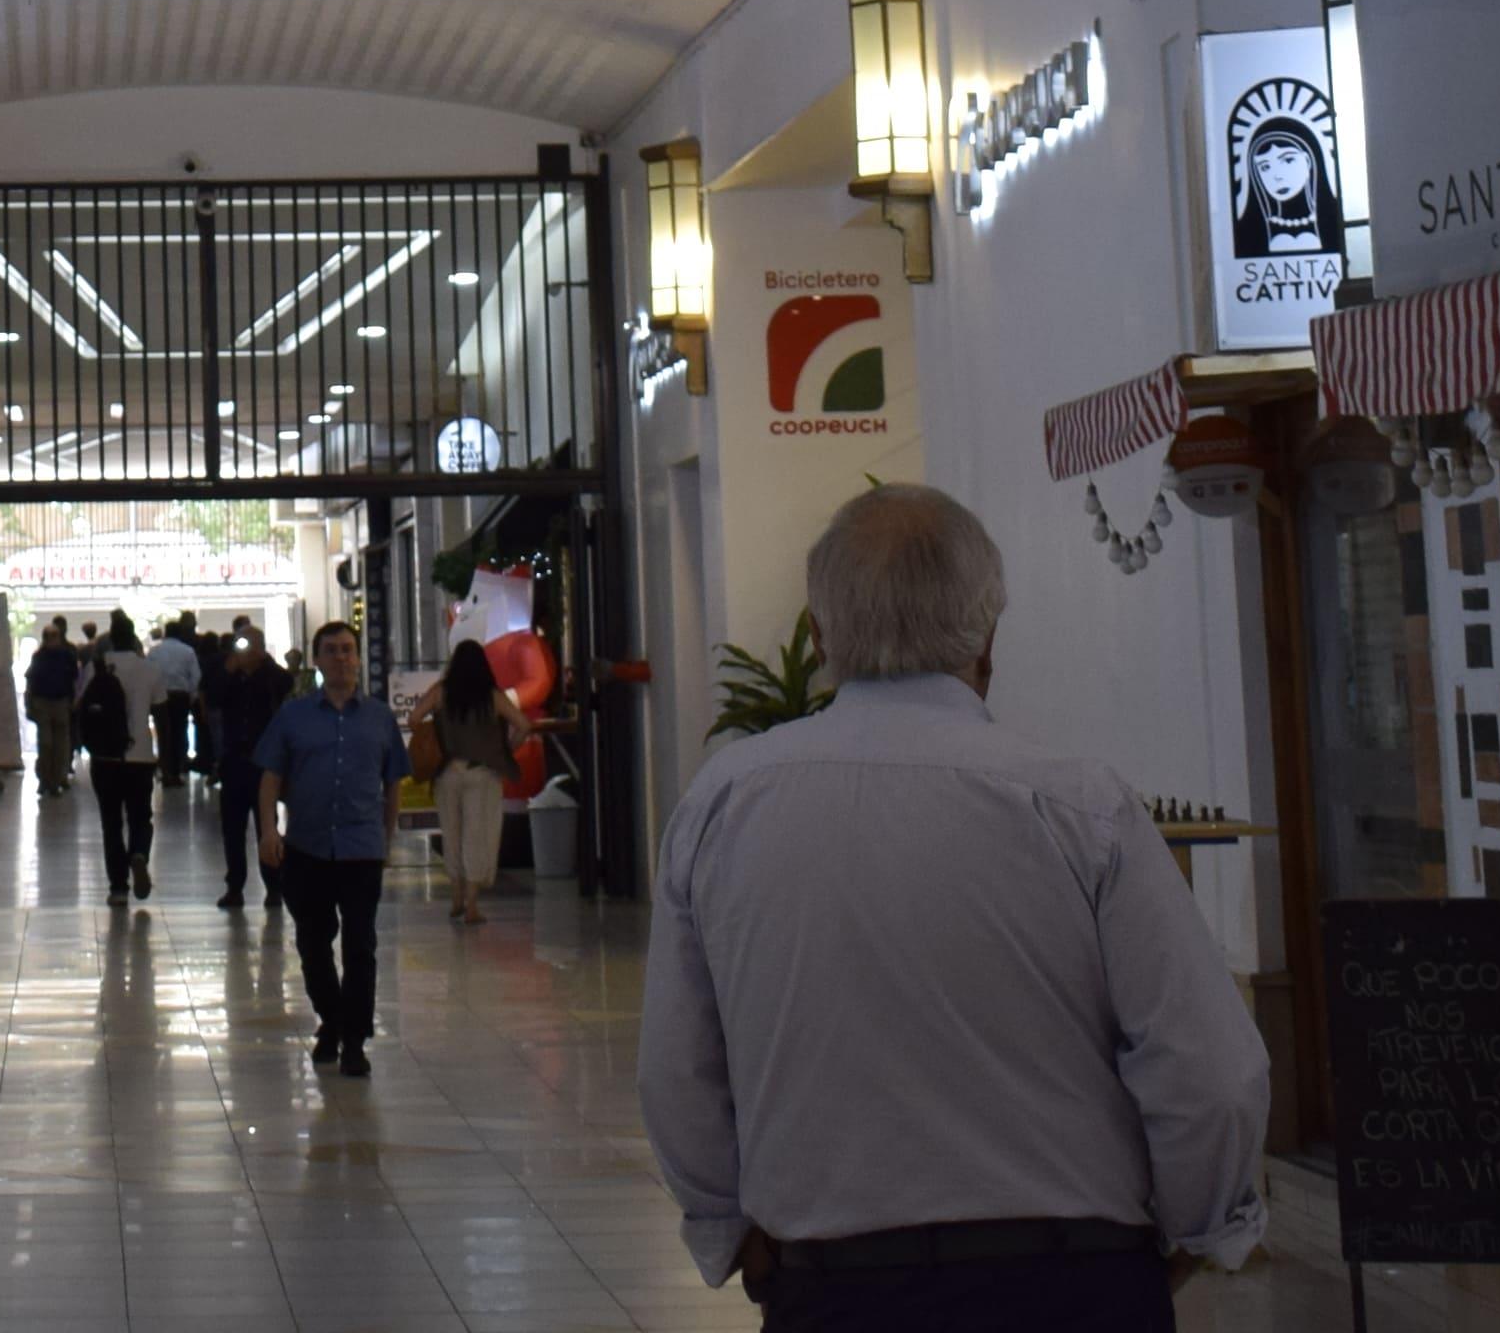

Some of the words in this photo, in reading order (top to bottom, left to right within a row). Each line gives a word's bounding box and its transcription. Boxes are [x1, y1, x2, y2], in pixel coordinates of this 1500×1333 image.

[765, 271, 880, 289] Bicicletero
[1244, 259, 1340, 283] SANTA
[1236, 280, 1333, 303] CATTIV
[1341, 961, 1401, 997] QUE
[1413, 961, 1500, 992] POCO
[1404, 1000, 1465, 1030] NOS
[1379, 1066, 1456, 1108] PARA
[1362, 1109, 1463, 1142] CORTA
[1352, 1157, 1401, 1189] ES
[1415, 1157, 1451, 1189] LA
